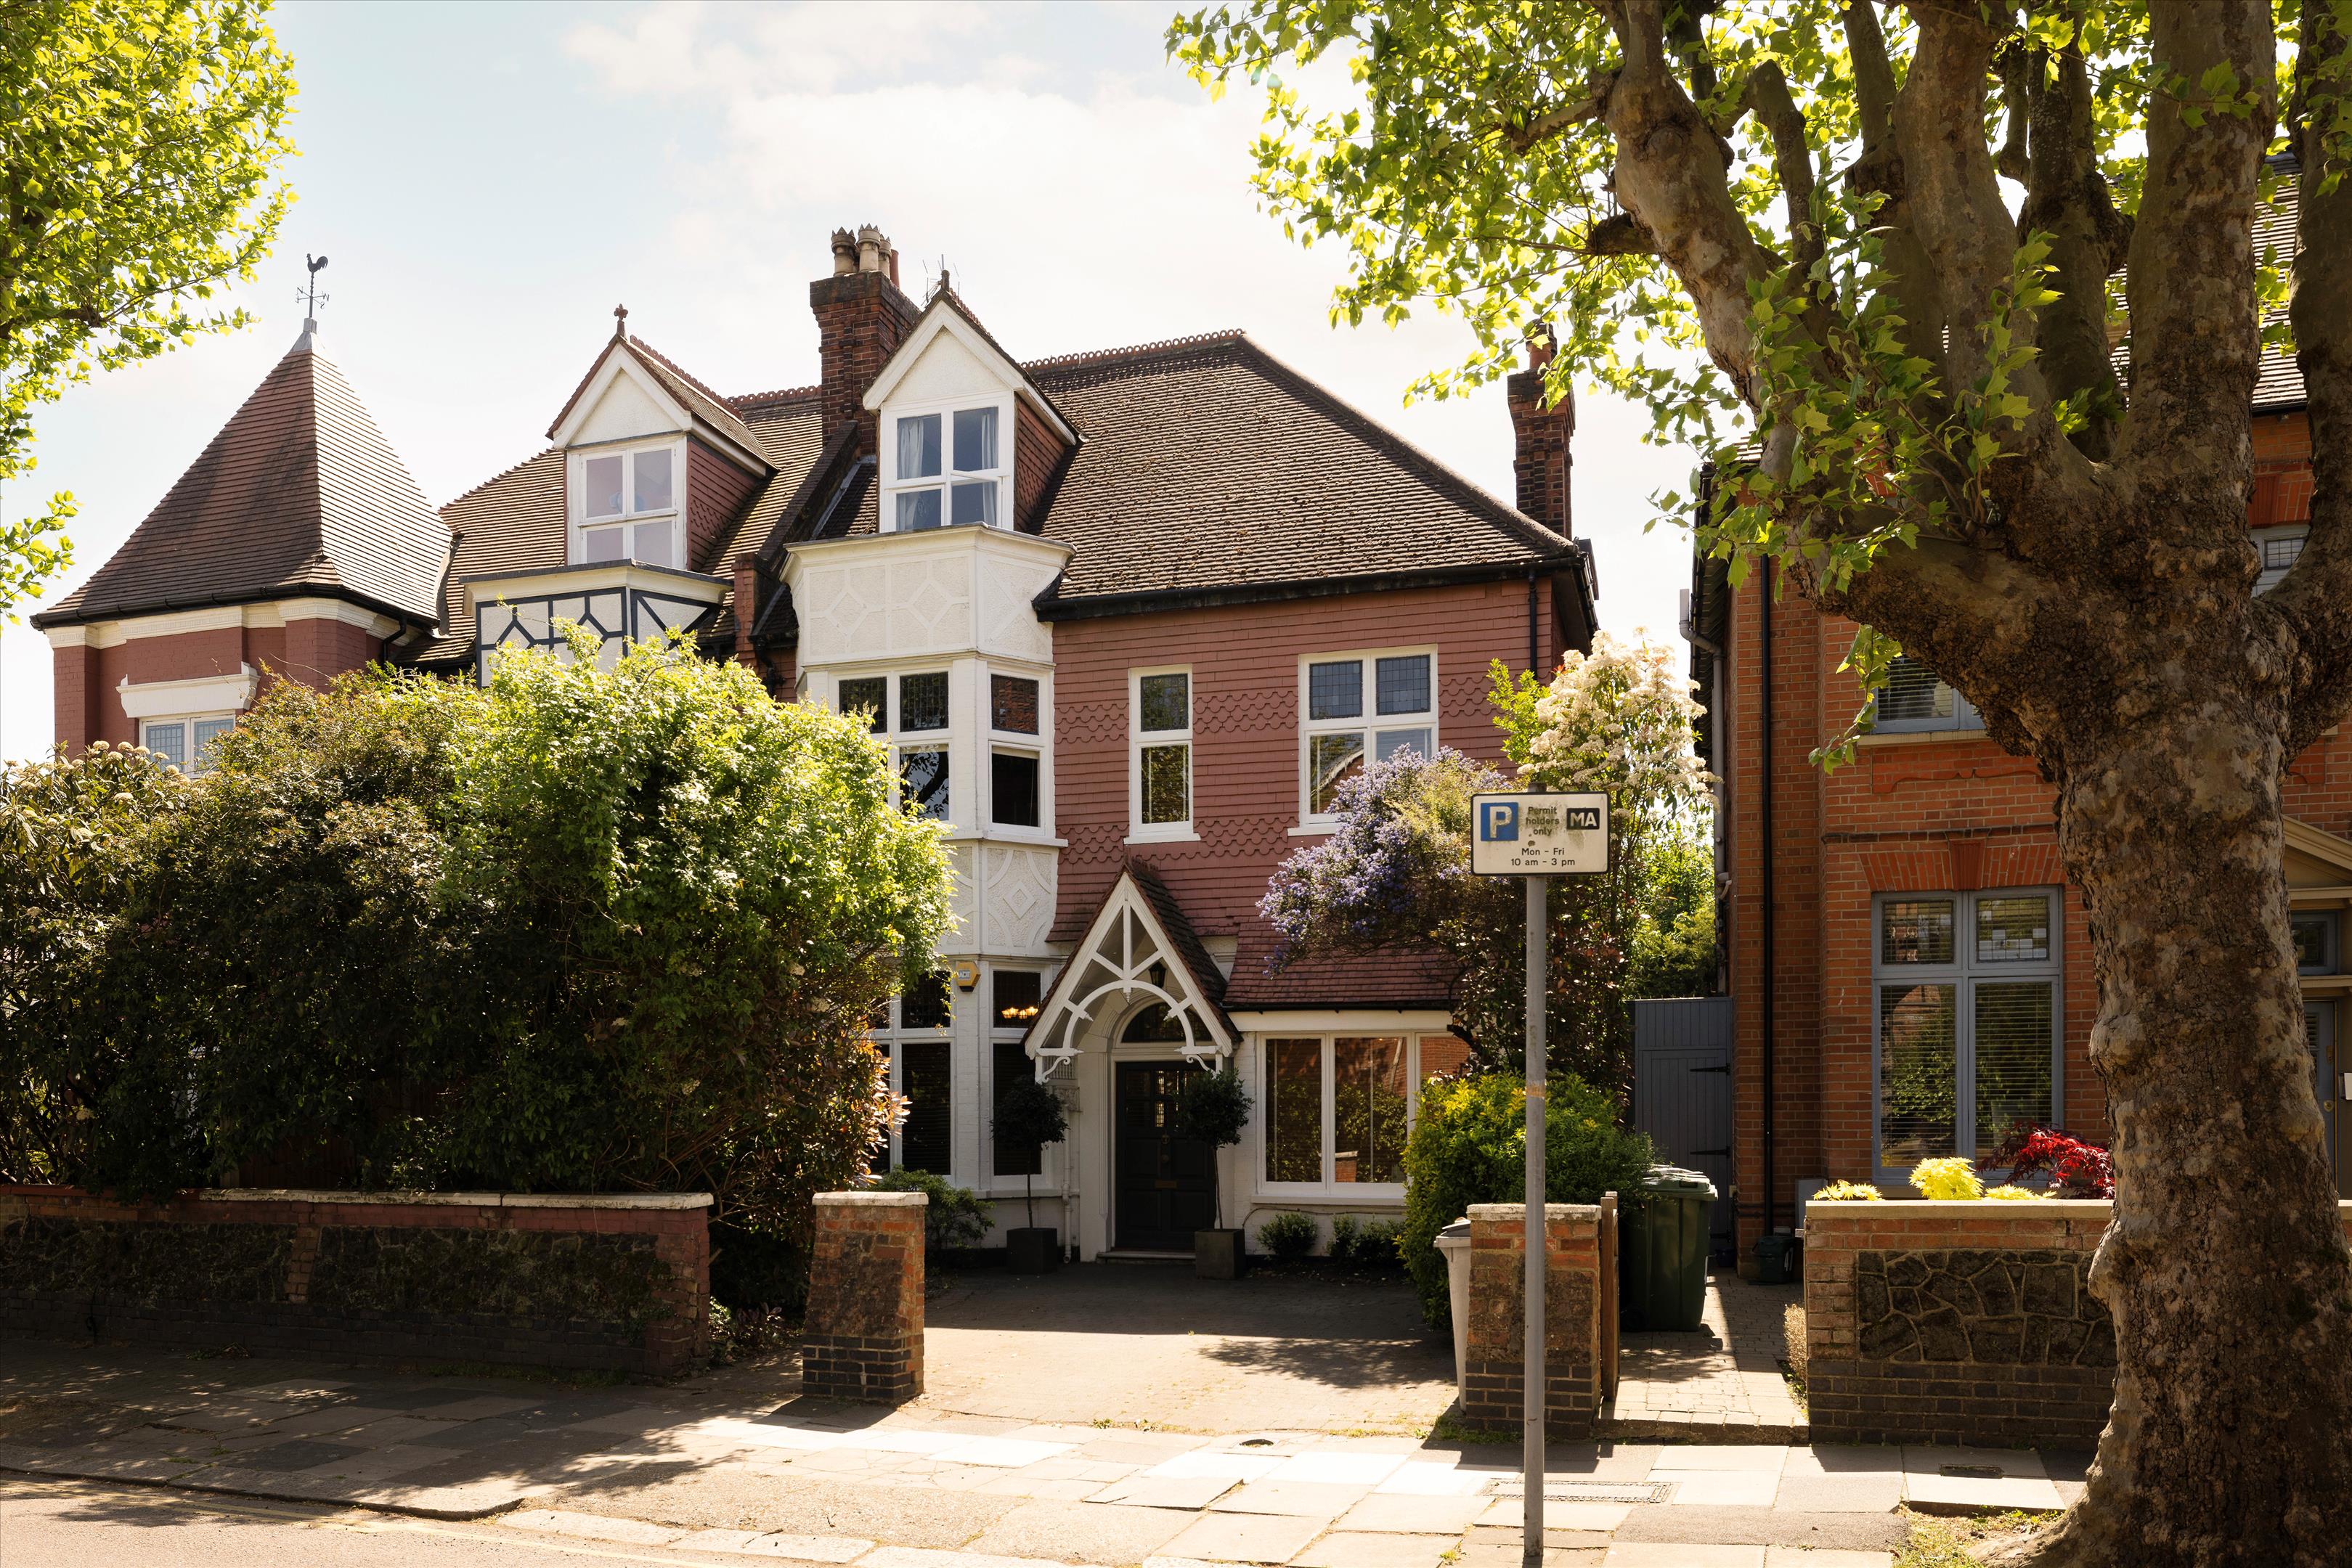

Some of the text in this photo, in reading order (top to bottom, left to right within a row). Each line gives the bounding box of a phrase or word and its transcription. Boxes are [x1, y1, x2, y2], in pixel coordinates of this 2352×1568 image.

[1489, 806, 1512, 838] P
[1570, 812, 1597, 827] MA
[1533, 828, 1553, 836] only
[1561, 859, 1575, 867] pm
